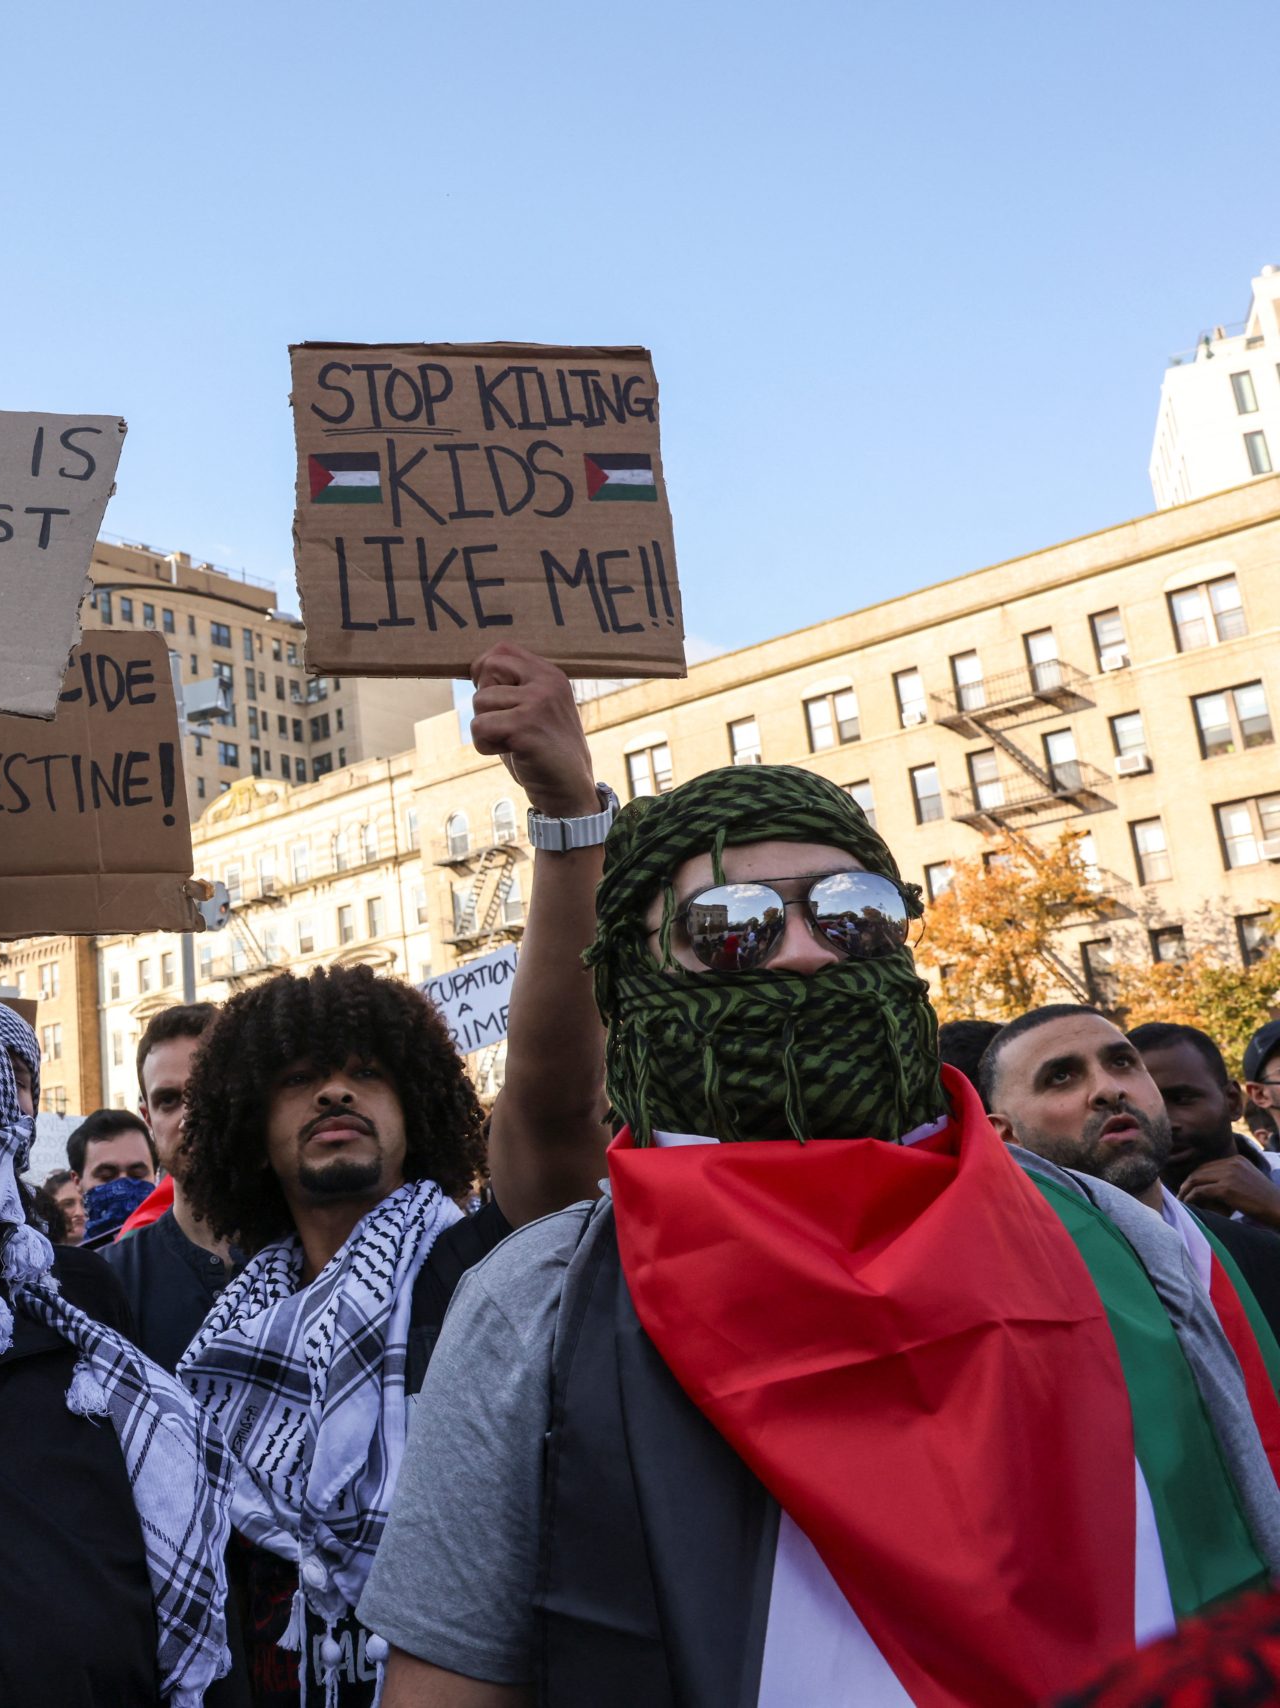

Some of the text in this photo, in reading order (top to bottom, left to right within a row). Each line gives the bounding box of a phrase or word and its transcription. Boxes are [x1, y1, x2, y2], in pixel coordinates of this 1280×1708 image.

[310, 361, 657, 431] STOP KILLING
[31, 426, 103, 481] IS
[386, 438, 575, 528] KIDS
[335, 536, 675, 634] LIKE ME!!
[422, 952, 517, 1006] CUPATION
[449, 1004, 510, 1050] RIME
[458, 1002, 473, 1018] A
